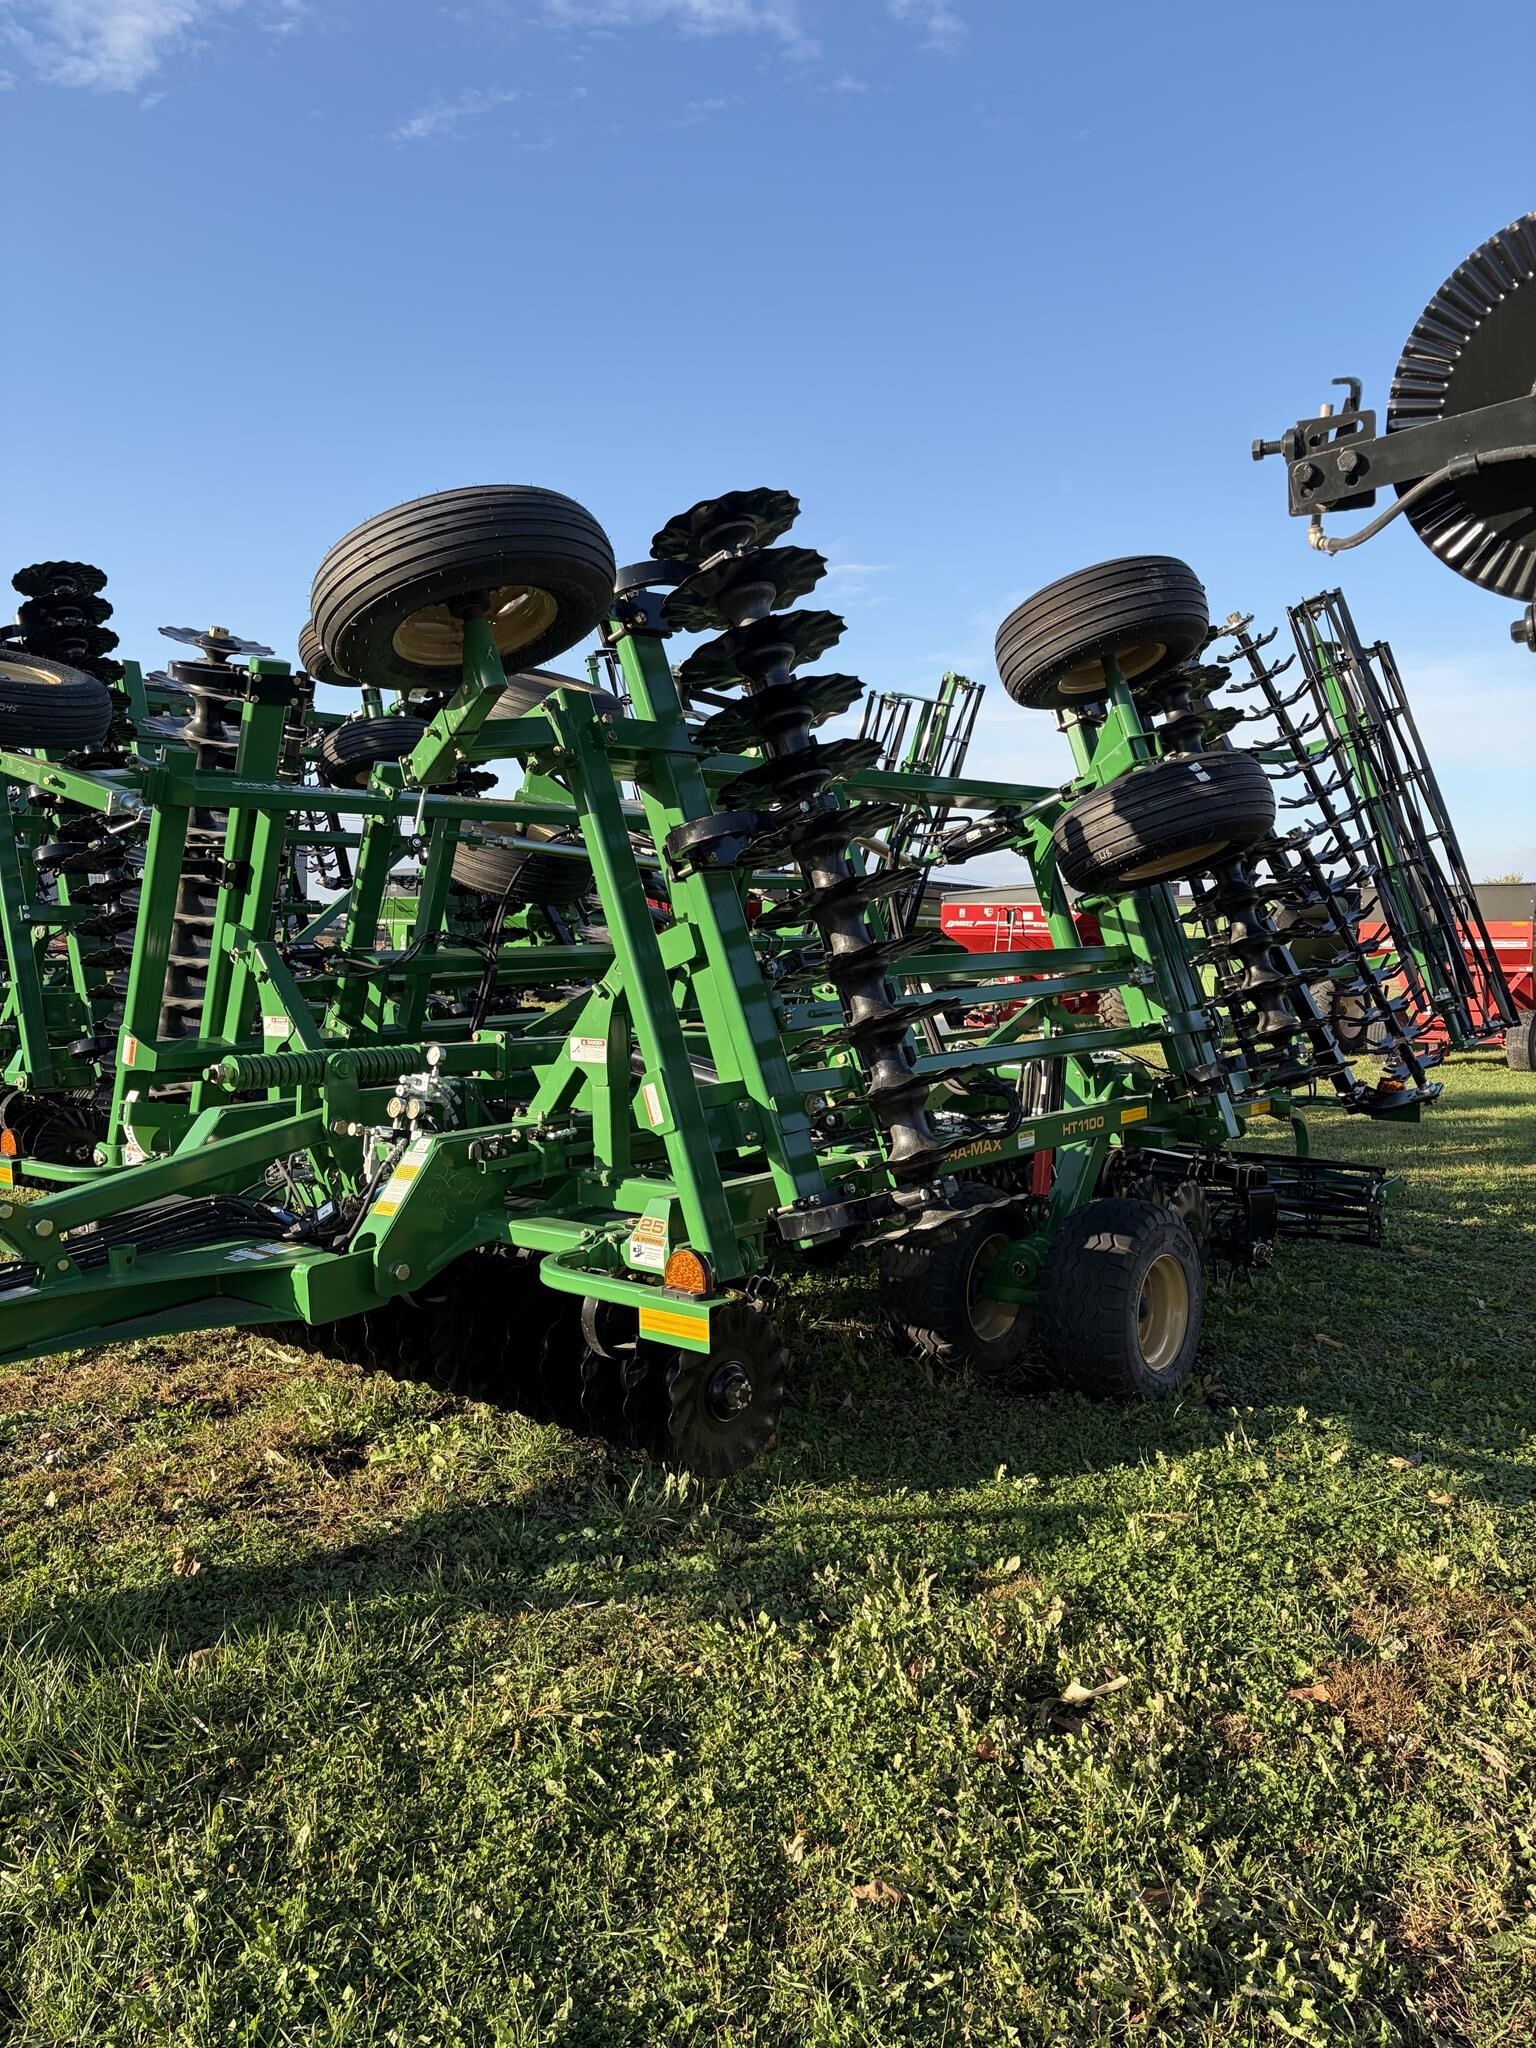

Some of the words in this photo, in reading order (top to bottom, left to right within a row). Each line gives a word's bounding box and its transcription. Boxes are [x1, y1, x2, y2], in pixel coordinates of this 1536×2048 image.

[1062, 1116, 1104, 1136] HT1100
[945, 1140, 1002, 1162] RA-MAX
[639, 1217, 666, 1235] 25
